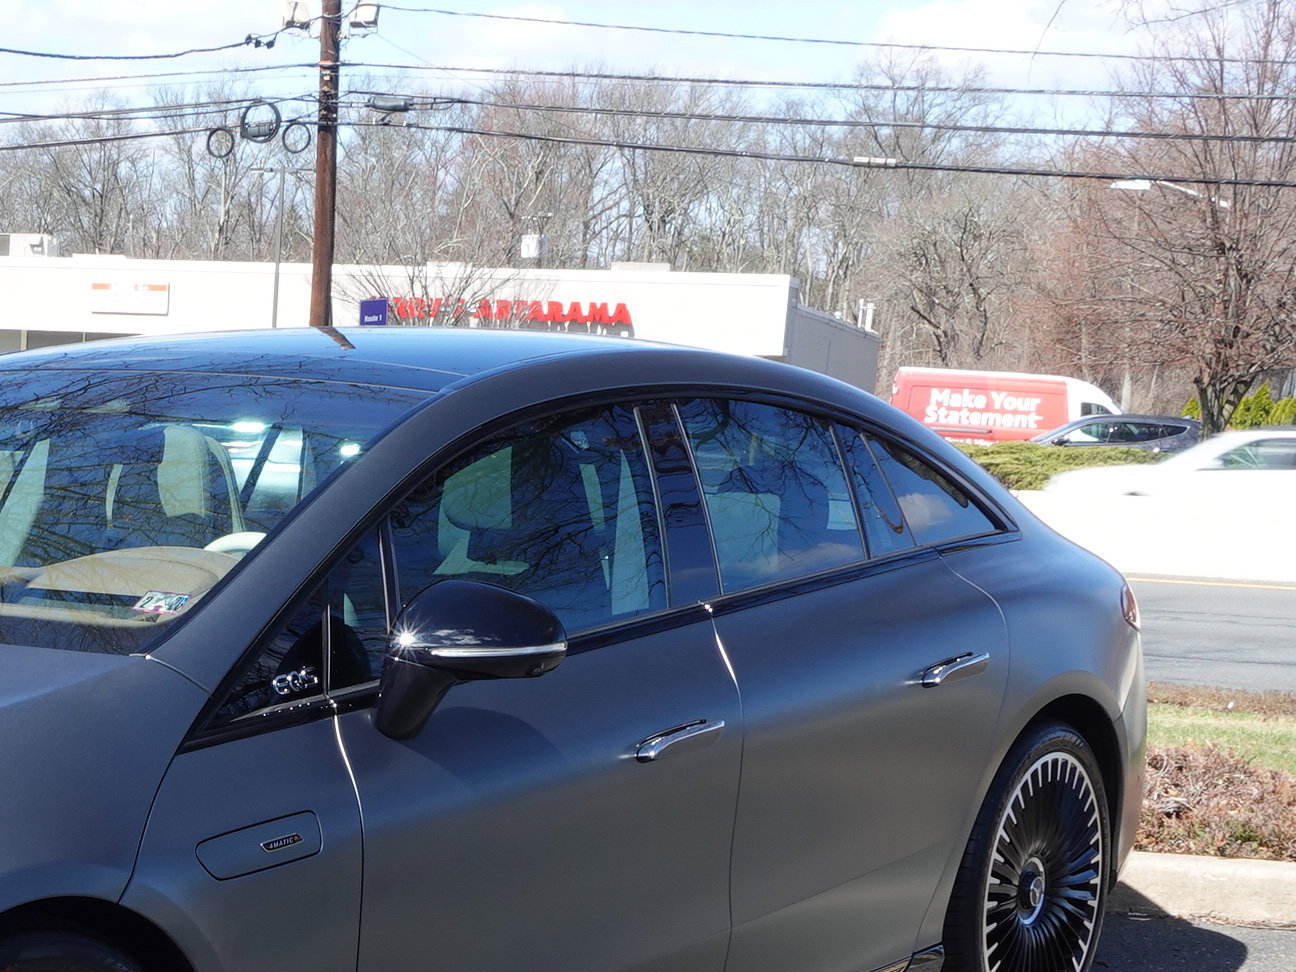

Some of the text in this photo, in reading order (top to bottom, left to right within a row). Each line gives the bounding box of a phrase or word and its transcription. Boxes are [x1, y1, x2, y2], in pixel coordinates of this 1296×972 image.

[473, 298, 632, 325] ARTARAMA
[930, 388, 1041, 412] Make Your
[924, 405, 1043, 429] Statement
[273, 666, 318, 695] EQS
